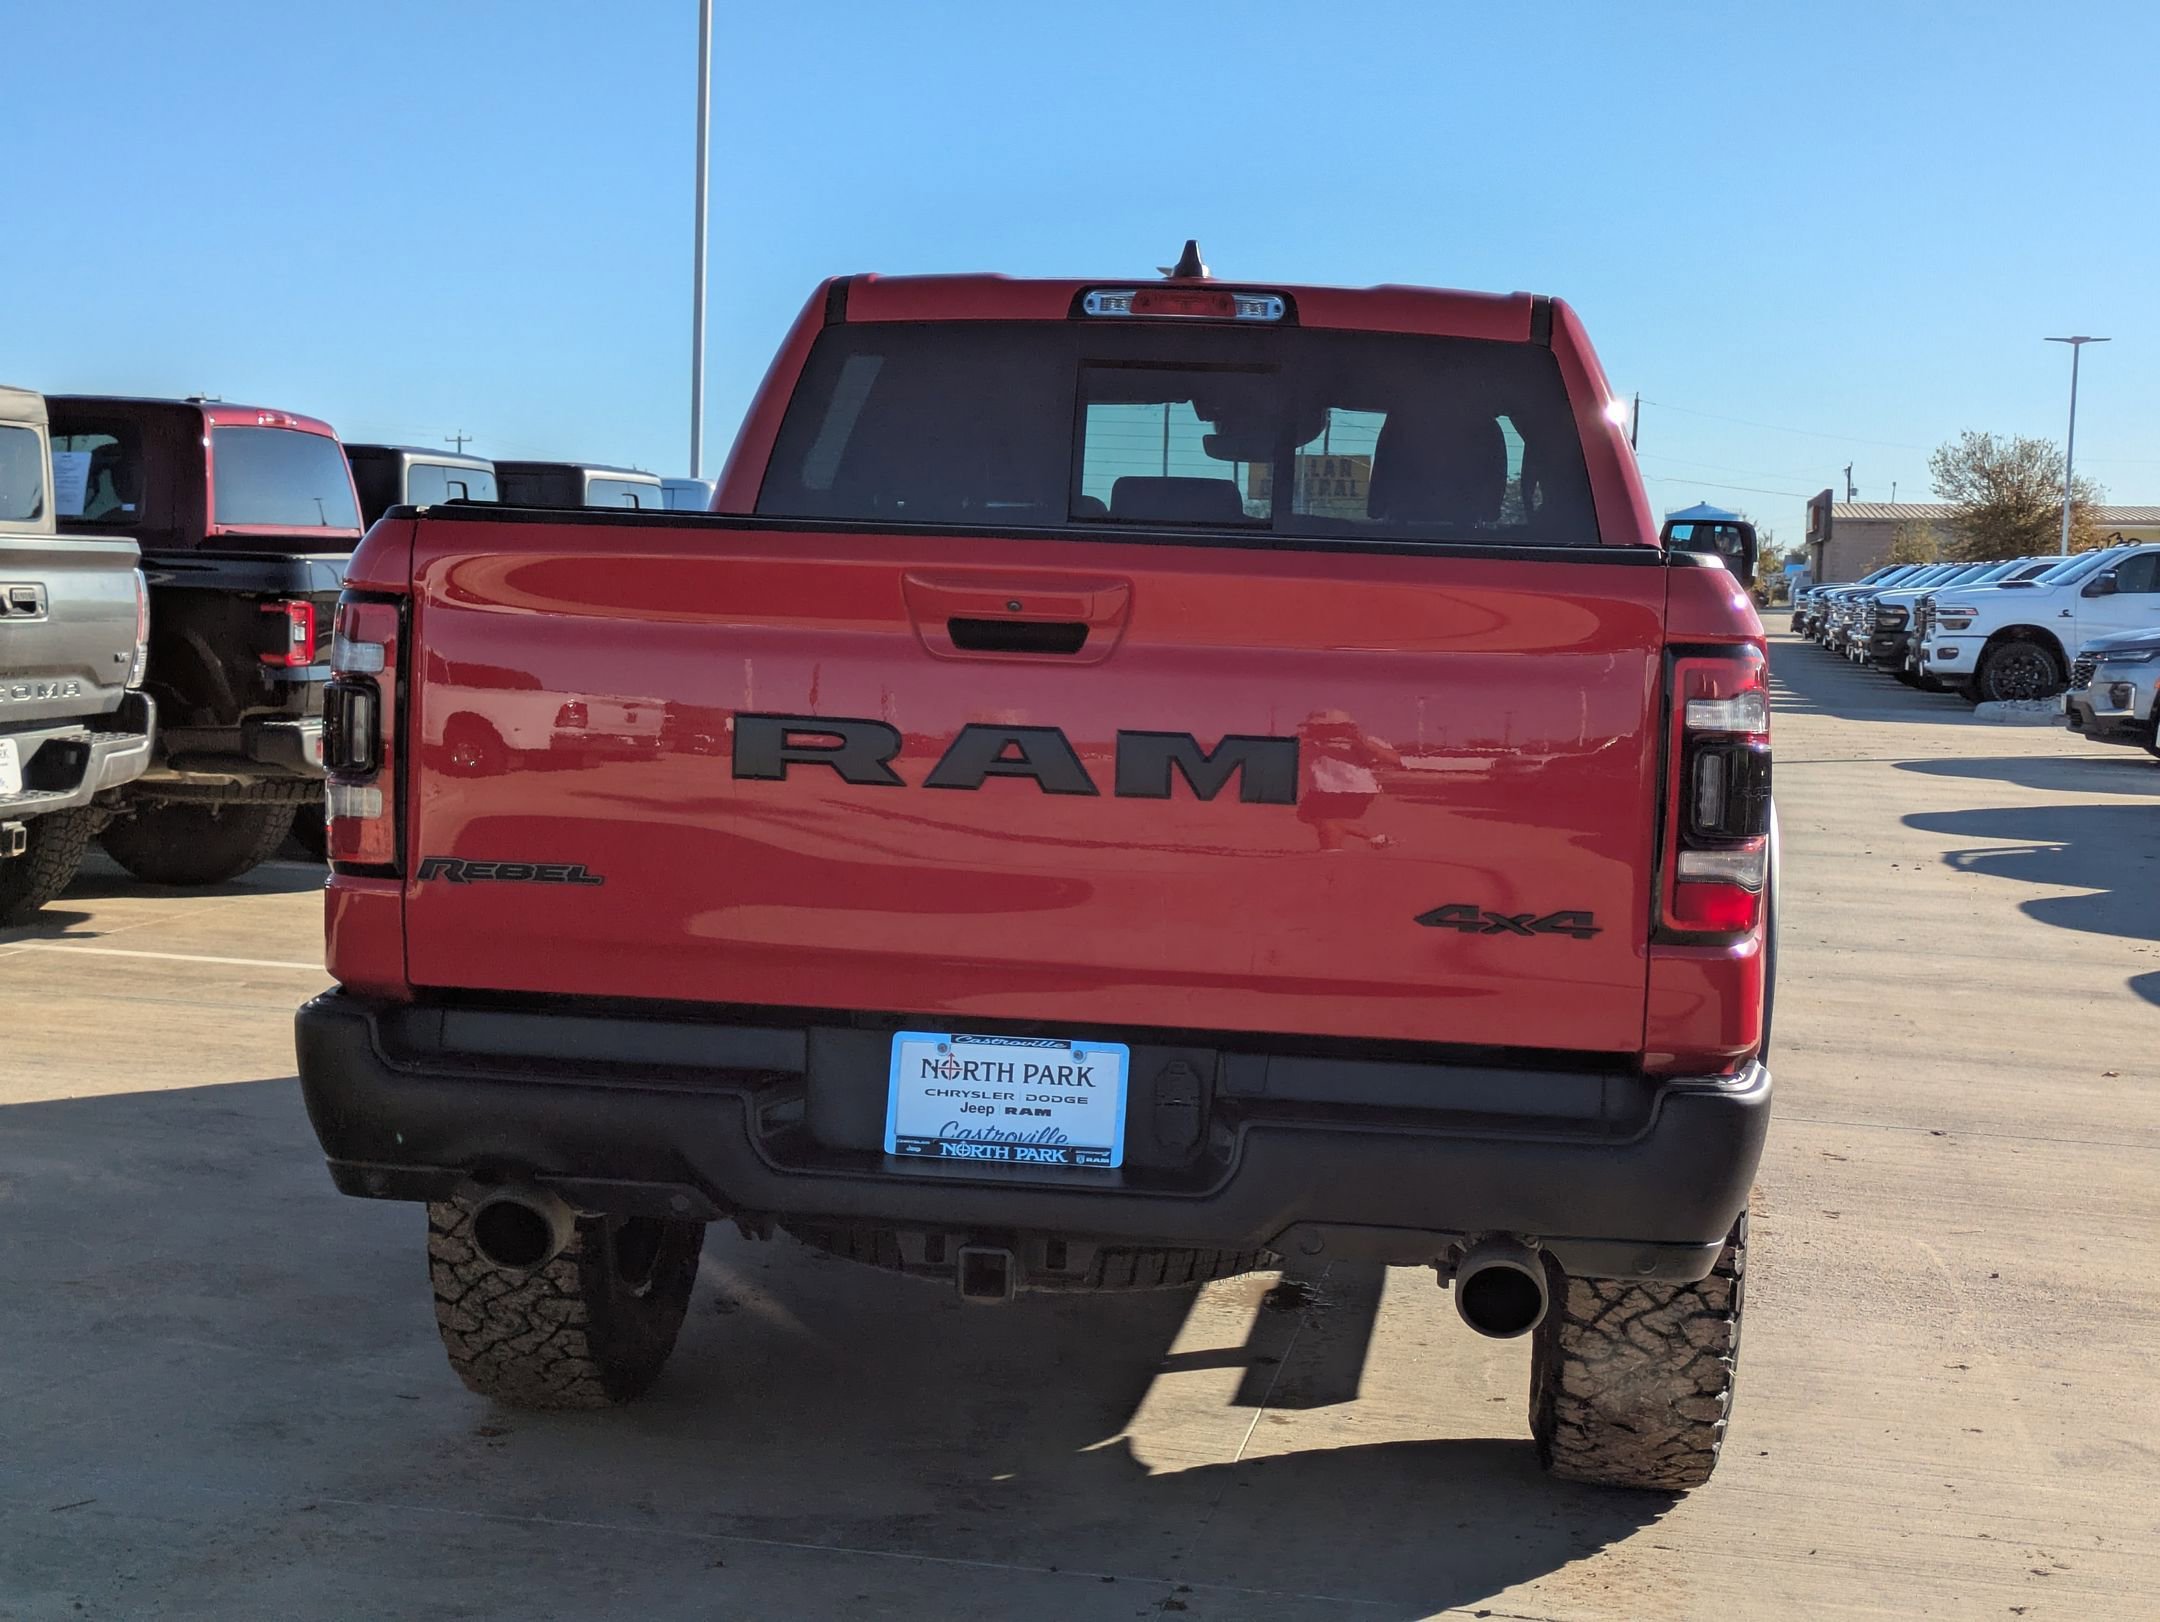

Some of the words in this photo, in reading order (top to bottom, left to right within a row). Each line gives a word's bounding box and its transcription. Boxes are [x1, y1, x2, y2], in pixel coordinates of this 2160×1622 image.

[0, 680, 81, 703] OMA
[732, 711, 1299, 805] RAM
[416, 855, 604, 885] REBEL
[1413, 903, 1604, 940] 4x4
[955, 1035, 1068, 1048] Castroville
[920, 1058, 1015, 1083] NORTH
[1023, 1063, 1096, 1088] PARK
[924, 1088, 1015, 1101] CHRYSLER
[1025, 1093, 1089, 1105] DODGE
[960, 1101, 995, 1117] Jeep
[1004, 1106, 1052, 1117] RAM
[939, 1142, 1009, 1160] NORTH
[1015, 1147, 1068, 1163] PARK
